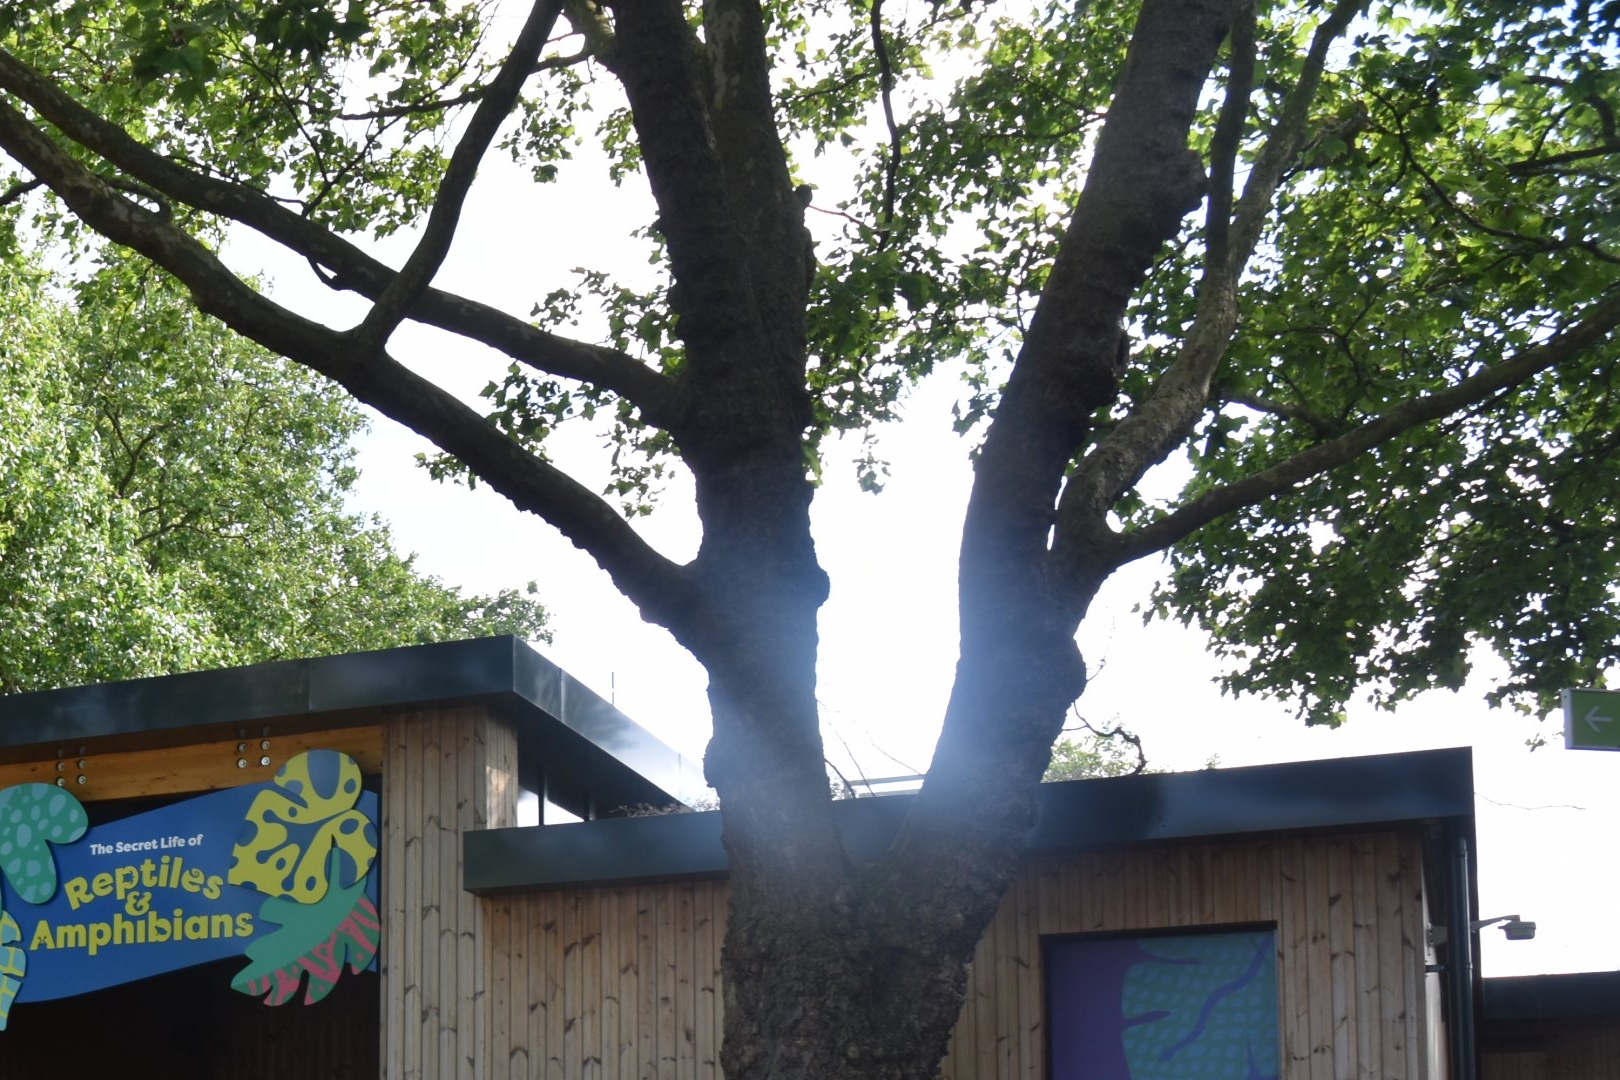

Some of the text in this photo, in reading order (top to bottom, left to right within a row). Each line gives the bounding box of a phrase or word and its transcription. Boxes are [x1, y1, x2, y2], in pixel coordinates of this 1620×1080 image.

[90, 834, 204, 855] The Secret Life of
[64, 855, 224, 910] Reptiles
[124, 891, 152, 916] &
[30, 908, 253, 955] Amphibians
